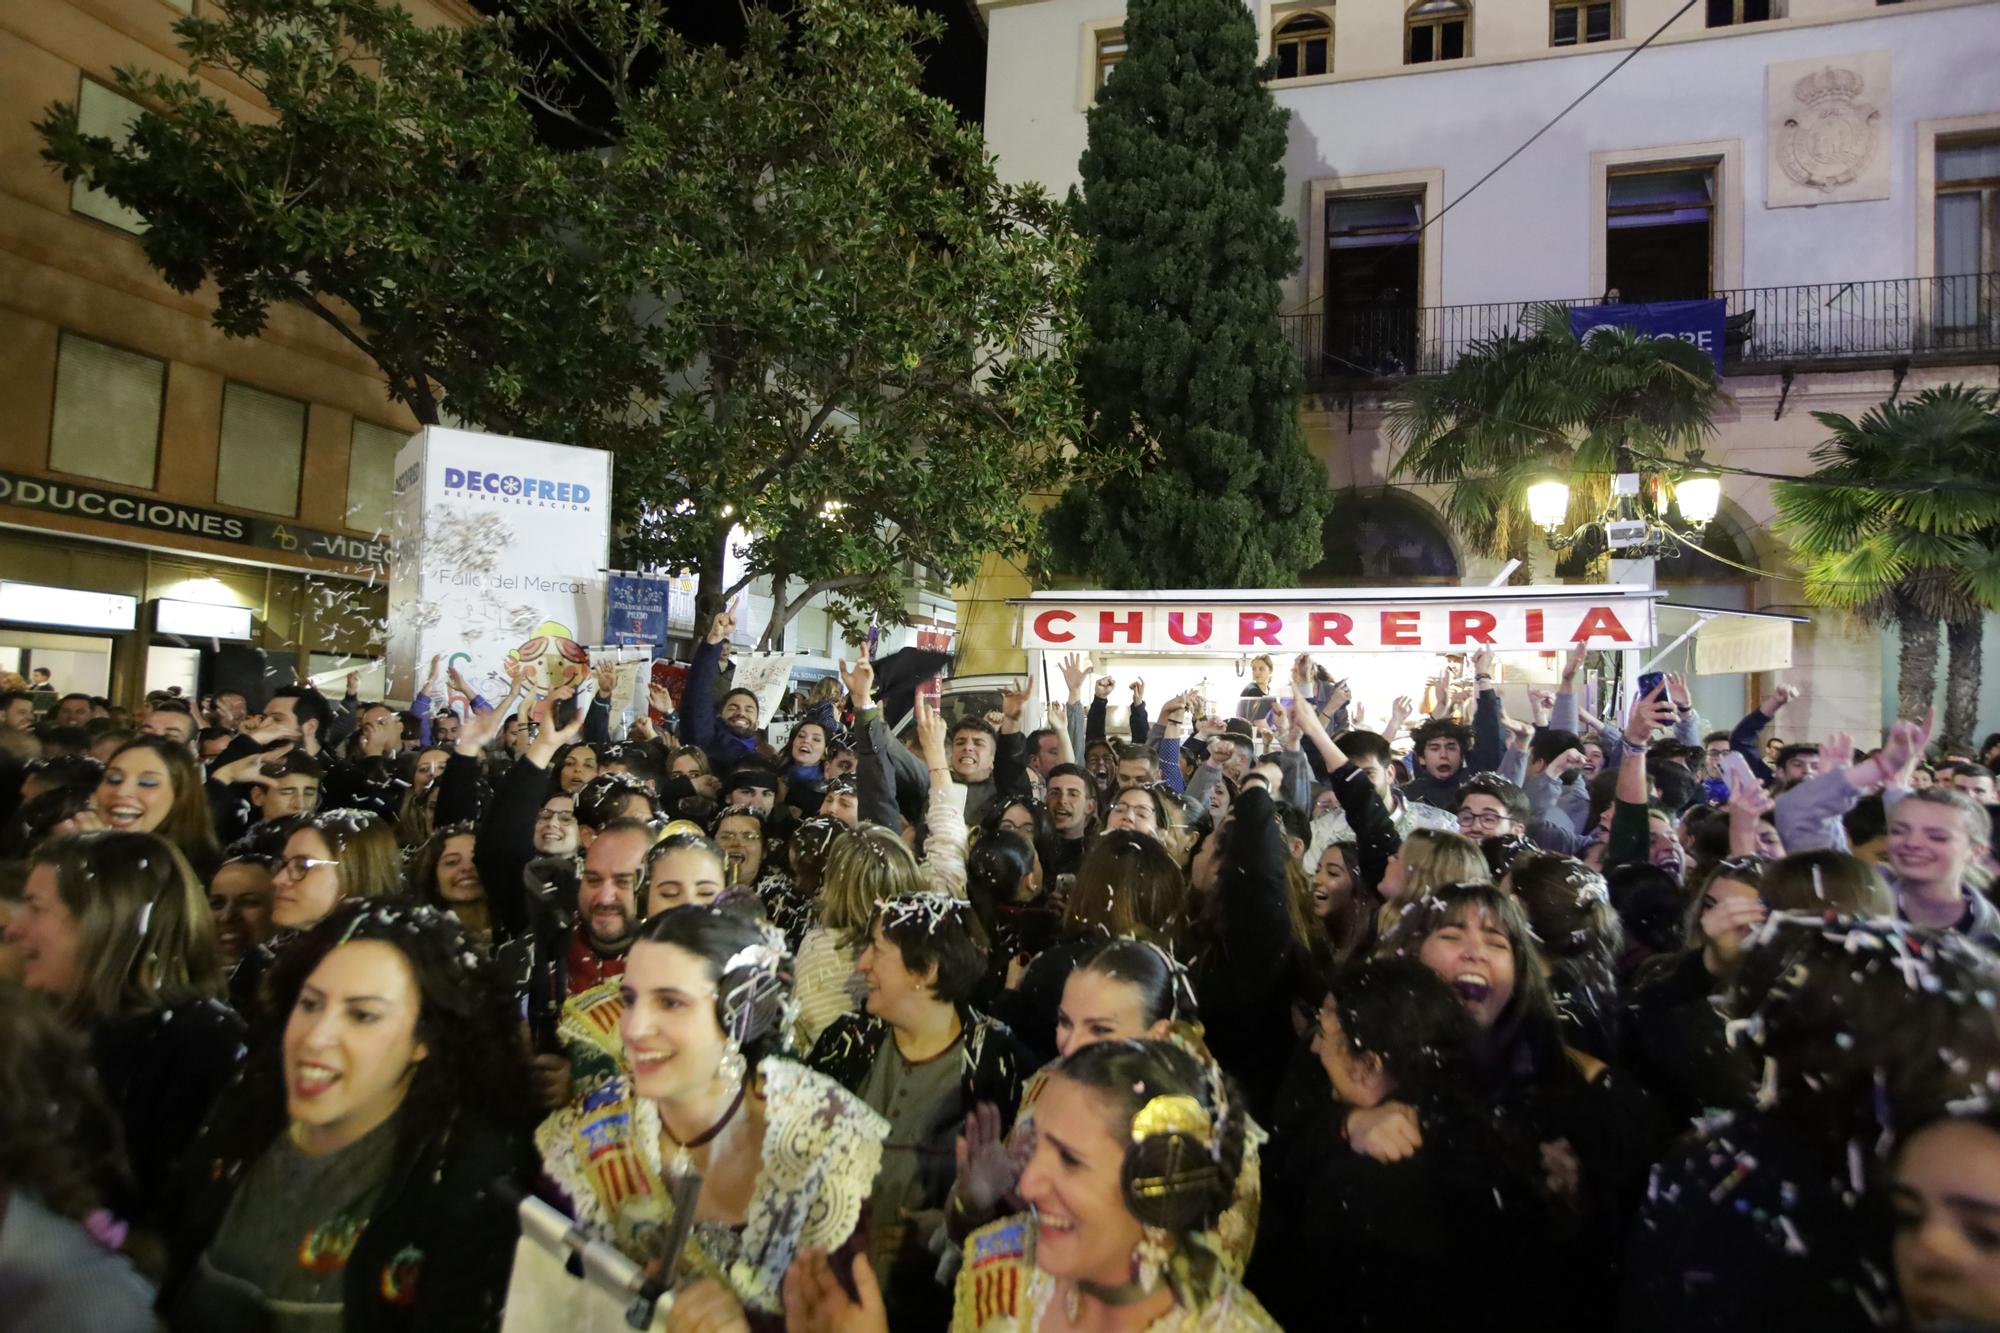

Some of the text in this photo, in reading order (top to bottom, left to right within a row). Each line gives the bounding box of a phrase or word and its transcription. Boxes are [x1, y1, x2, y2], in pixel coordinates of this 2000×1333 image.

[444, 467, 591, 504] DECOFRED
[489, 574, 519, 590] del
[524, 575, 587, 595] Mercat
[1032, 606, 1633, 647] CHURRERIA
